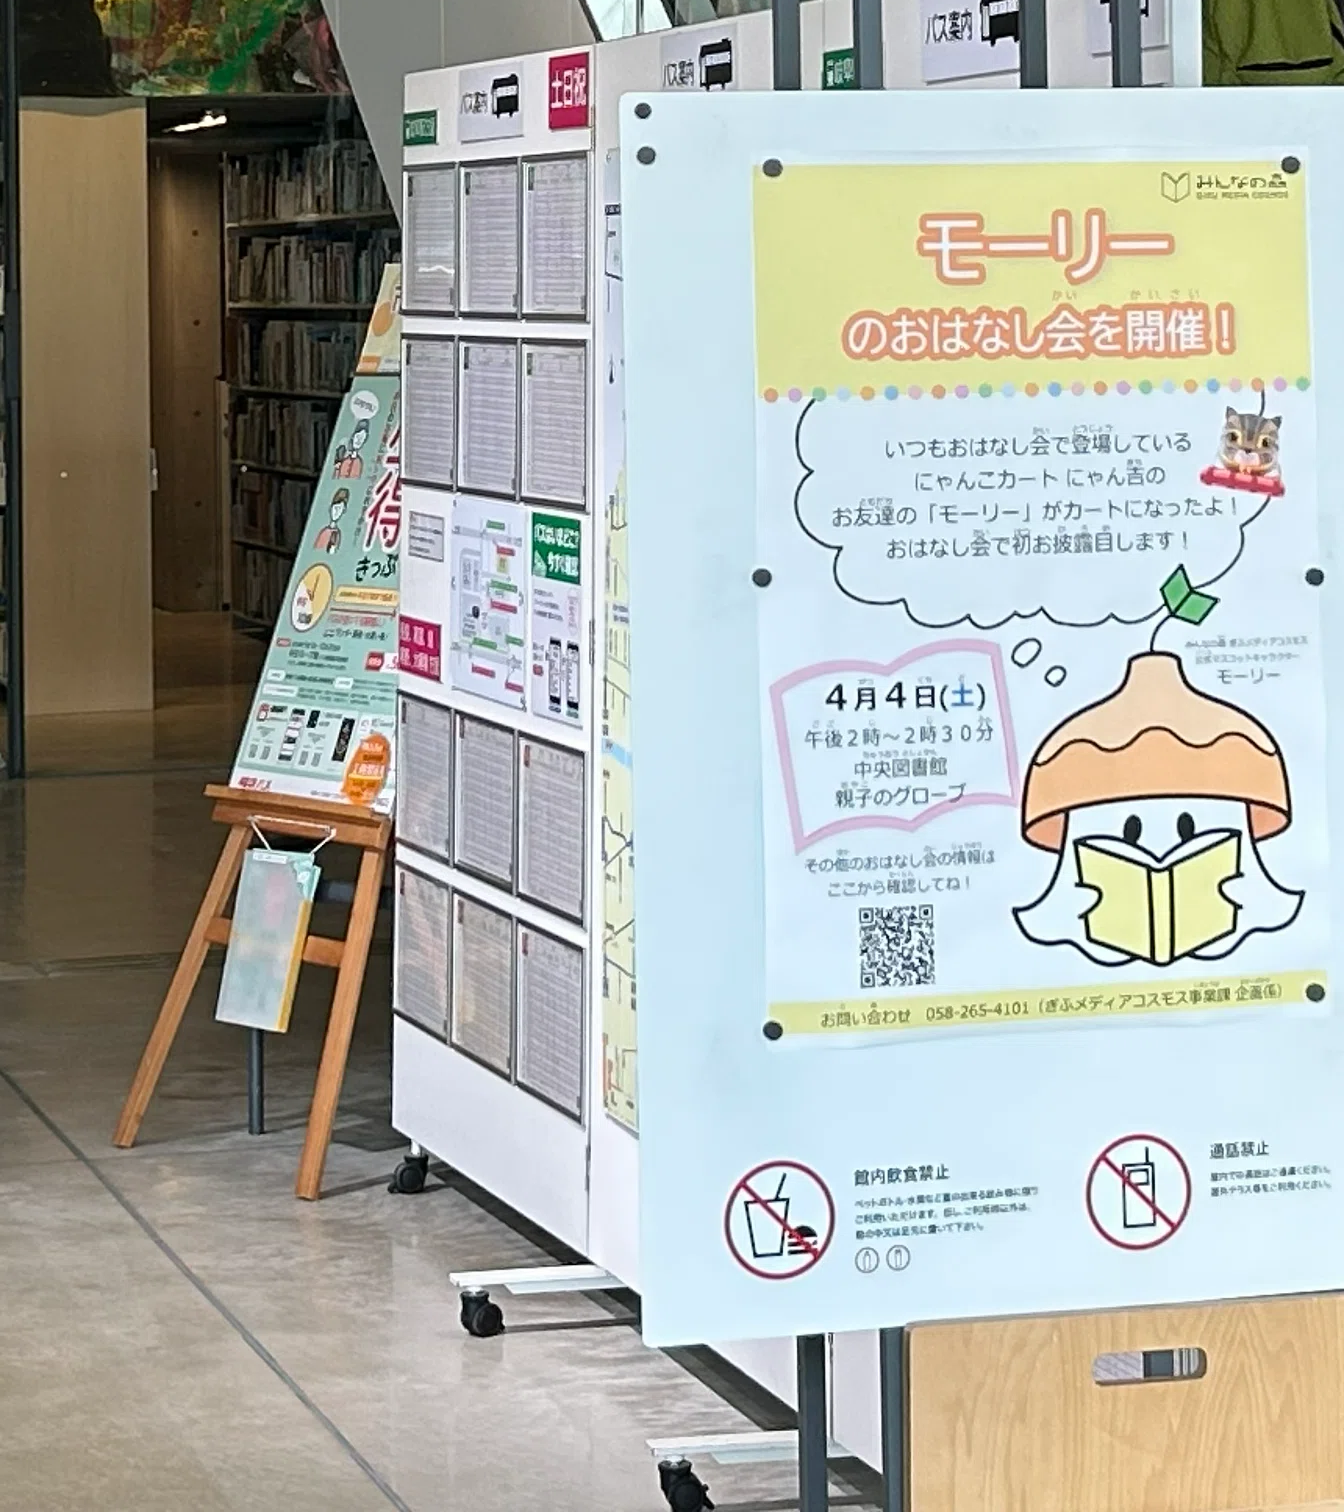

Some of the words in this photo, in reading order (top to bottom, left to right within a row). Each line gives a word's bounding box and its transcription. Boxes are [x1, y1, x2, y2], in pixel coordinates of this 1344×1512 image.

[925, 7, 973, 45] バス案内
[550, 66, 587, 109] 土日祝
[918, 209, 1174, 284] モーリー
[843, 303, 1235, 361] のおはなし会を開催！
[885, 432, 1191, 459] いつもおはなし会で登場している
[914, 468, 1059, 492] にゃんこカート
[1066, 465, 1166, 487] にゃん吉の
[1216, 666, 1281, 685] モーリー
[854, 756, 948, 779] 中央図書館
[835, 783, 967, 809] 親子のグローブ
[820, 1008, 911, 1029] お問い合わせ
[925, 1000, 1029, 1022] 058-265-4101
[1210, 1140, 1270, 1159] 通話禁止
[854, 1163, 950, 1187] 館内飲食禁止
